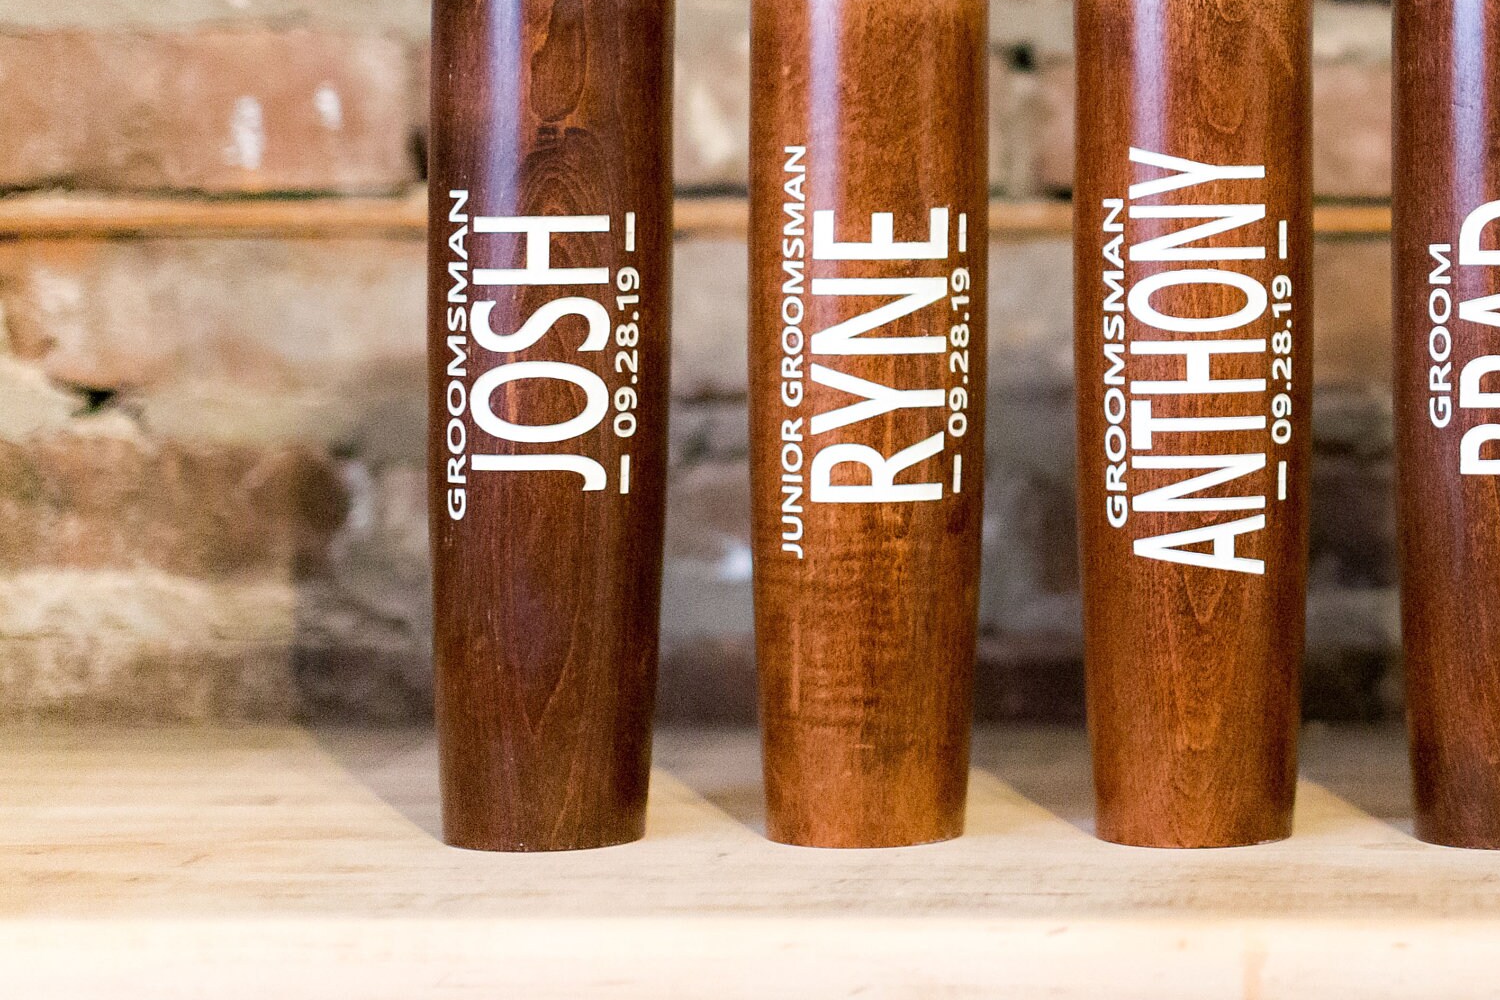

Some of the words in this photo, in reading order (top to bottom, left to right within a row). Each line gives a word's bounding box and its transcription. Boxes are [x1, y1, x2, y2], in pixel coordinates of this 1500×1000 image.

[447, 189, 470, 520] GROOMSMAN
[470, 214, 611, 491] JOSH
[781, 145, 807, 408] GROOMSMAN
[810, 207, 949, 503] RYNE
[1102, 198, 1128, 529] GROOMSMAN
[1128, 147, 1268, 575] ANTHONY
[1428, 243, 1452, 428] GROOM
[781, 417, 803, 559] JUNIOR
